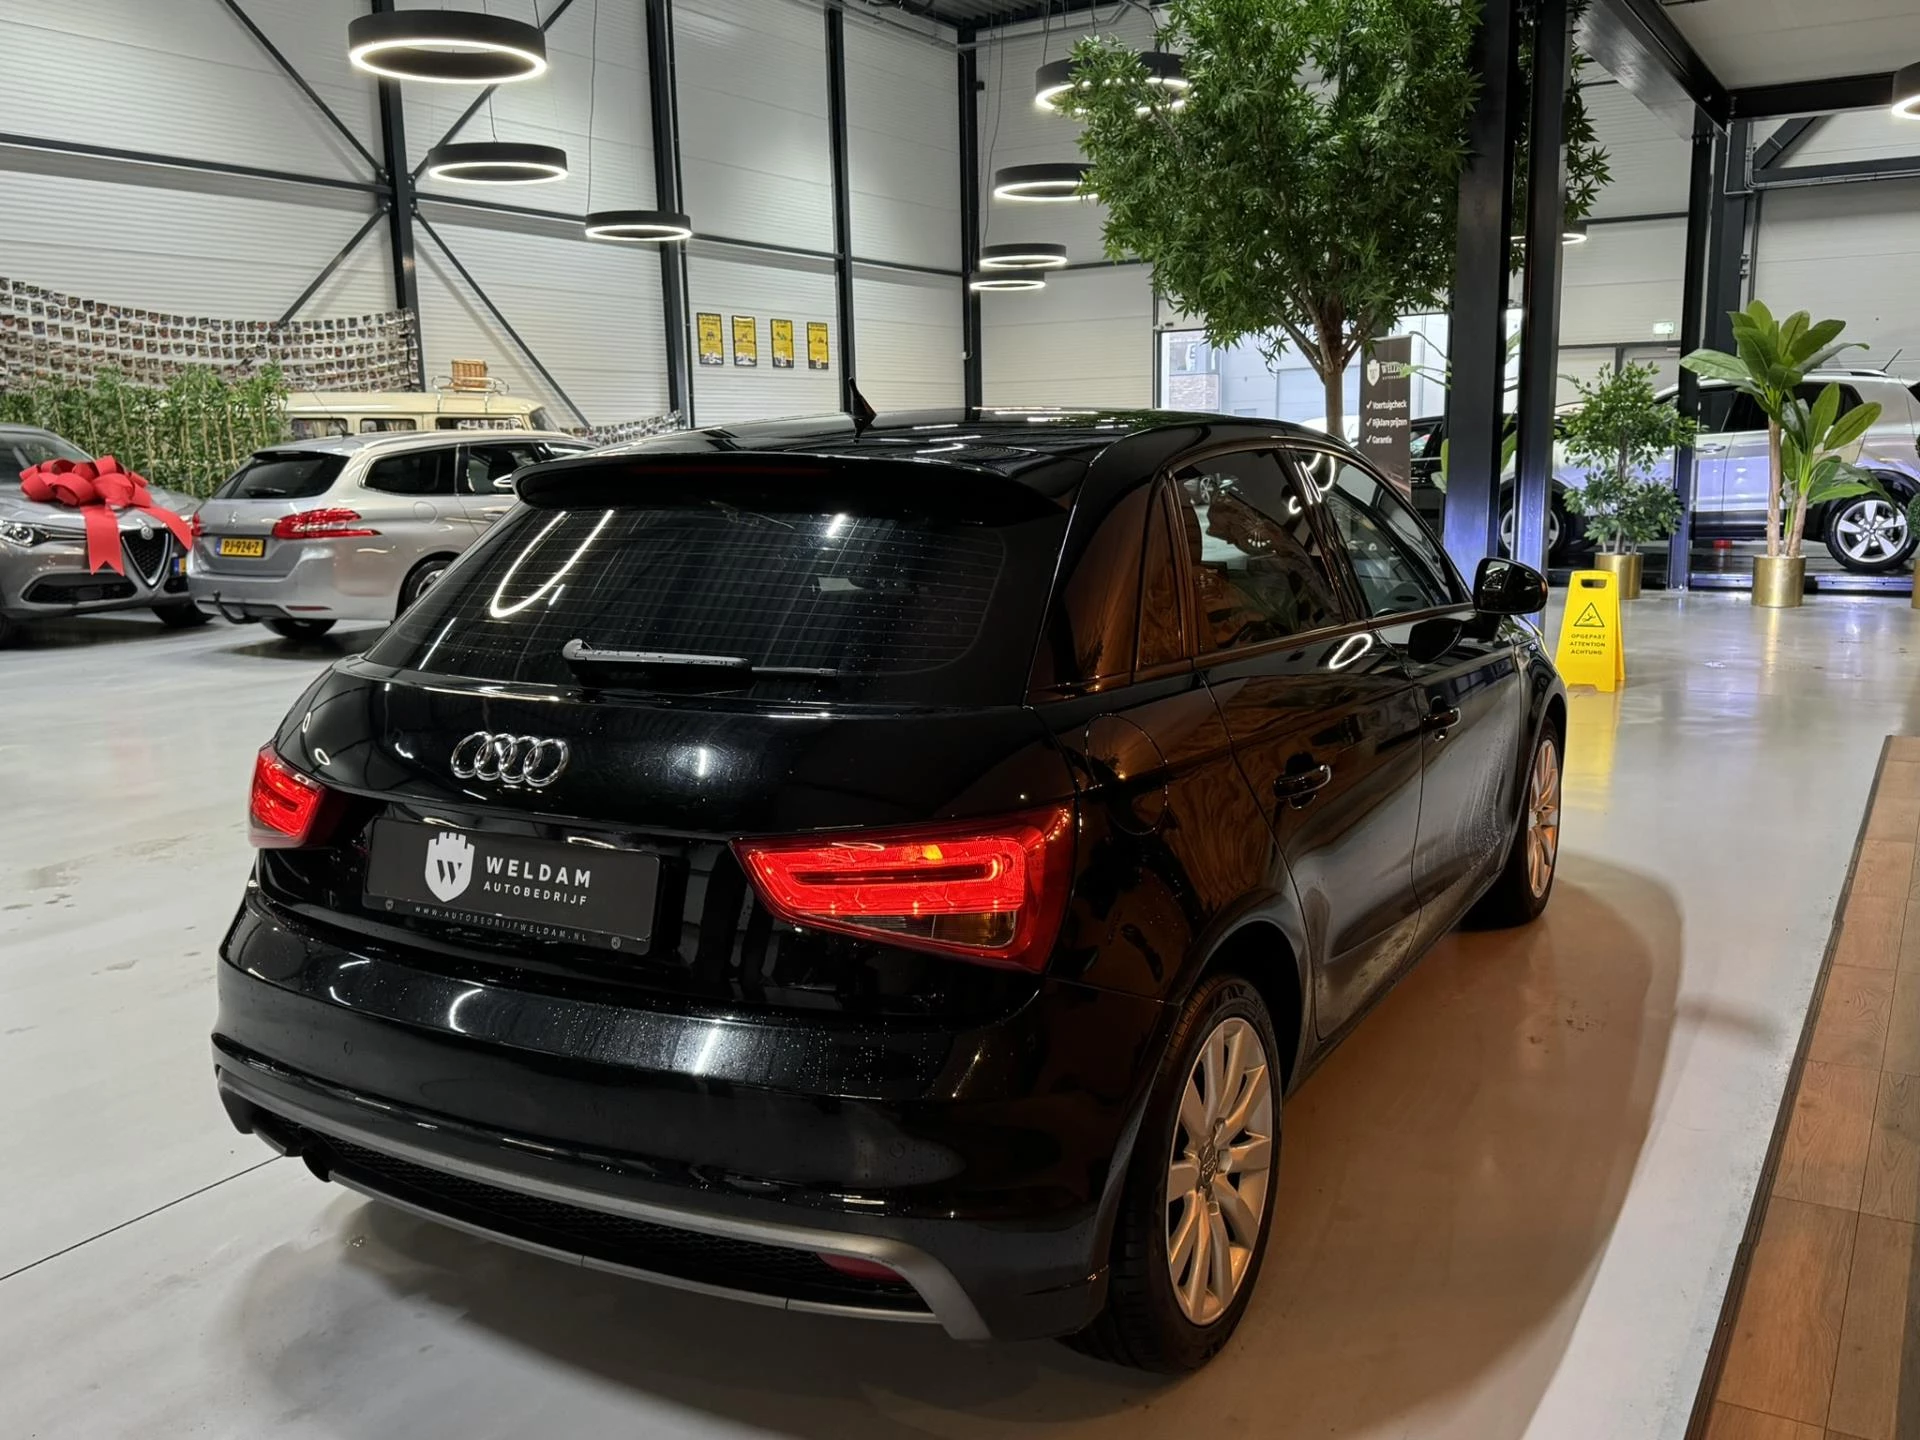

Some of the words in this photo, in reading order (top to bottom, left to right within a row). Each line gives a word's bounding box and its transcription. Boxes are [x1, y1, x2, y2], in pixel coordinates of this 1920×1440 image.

[1372, 436, 1392, 444] Garantie
[224, 541, 260, 554] PJ-924-Z
[486, 856, 591, 888] WELDAM
[483, 881, 588, 906] AUTOBEDRIJF
